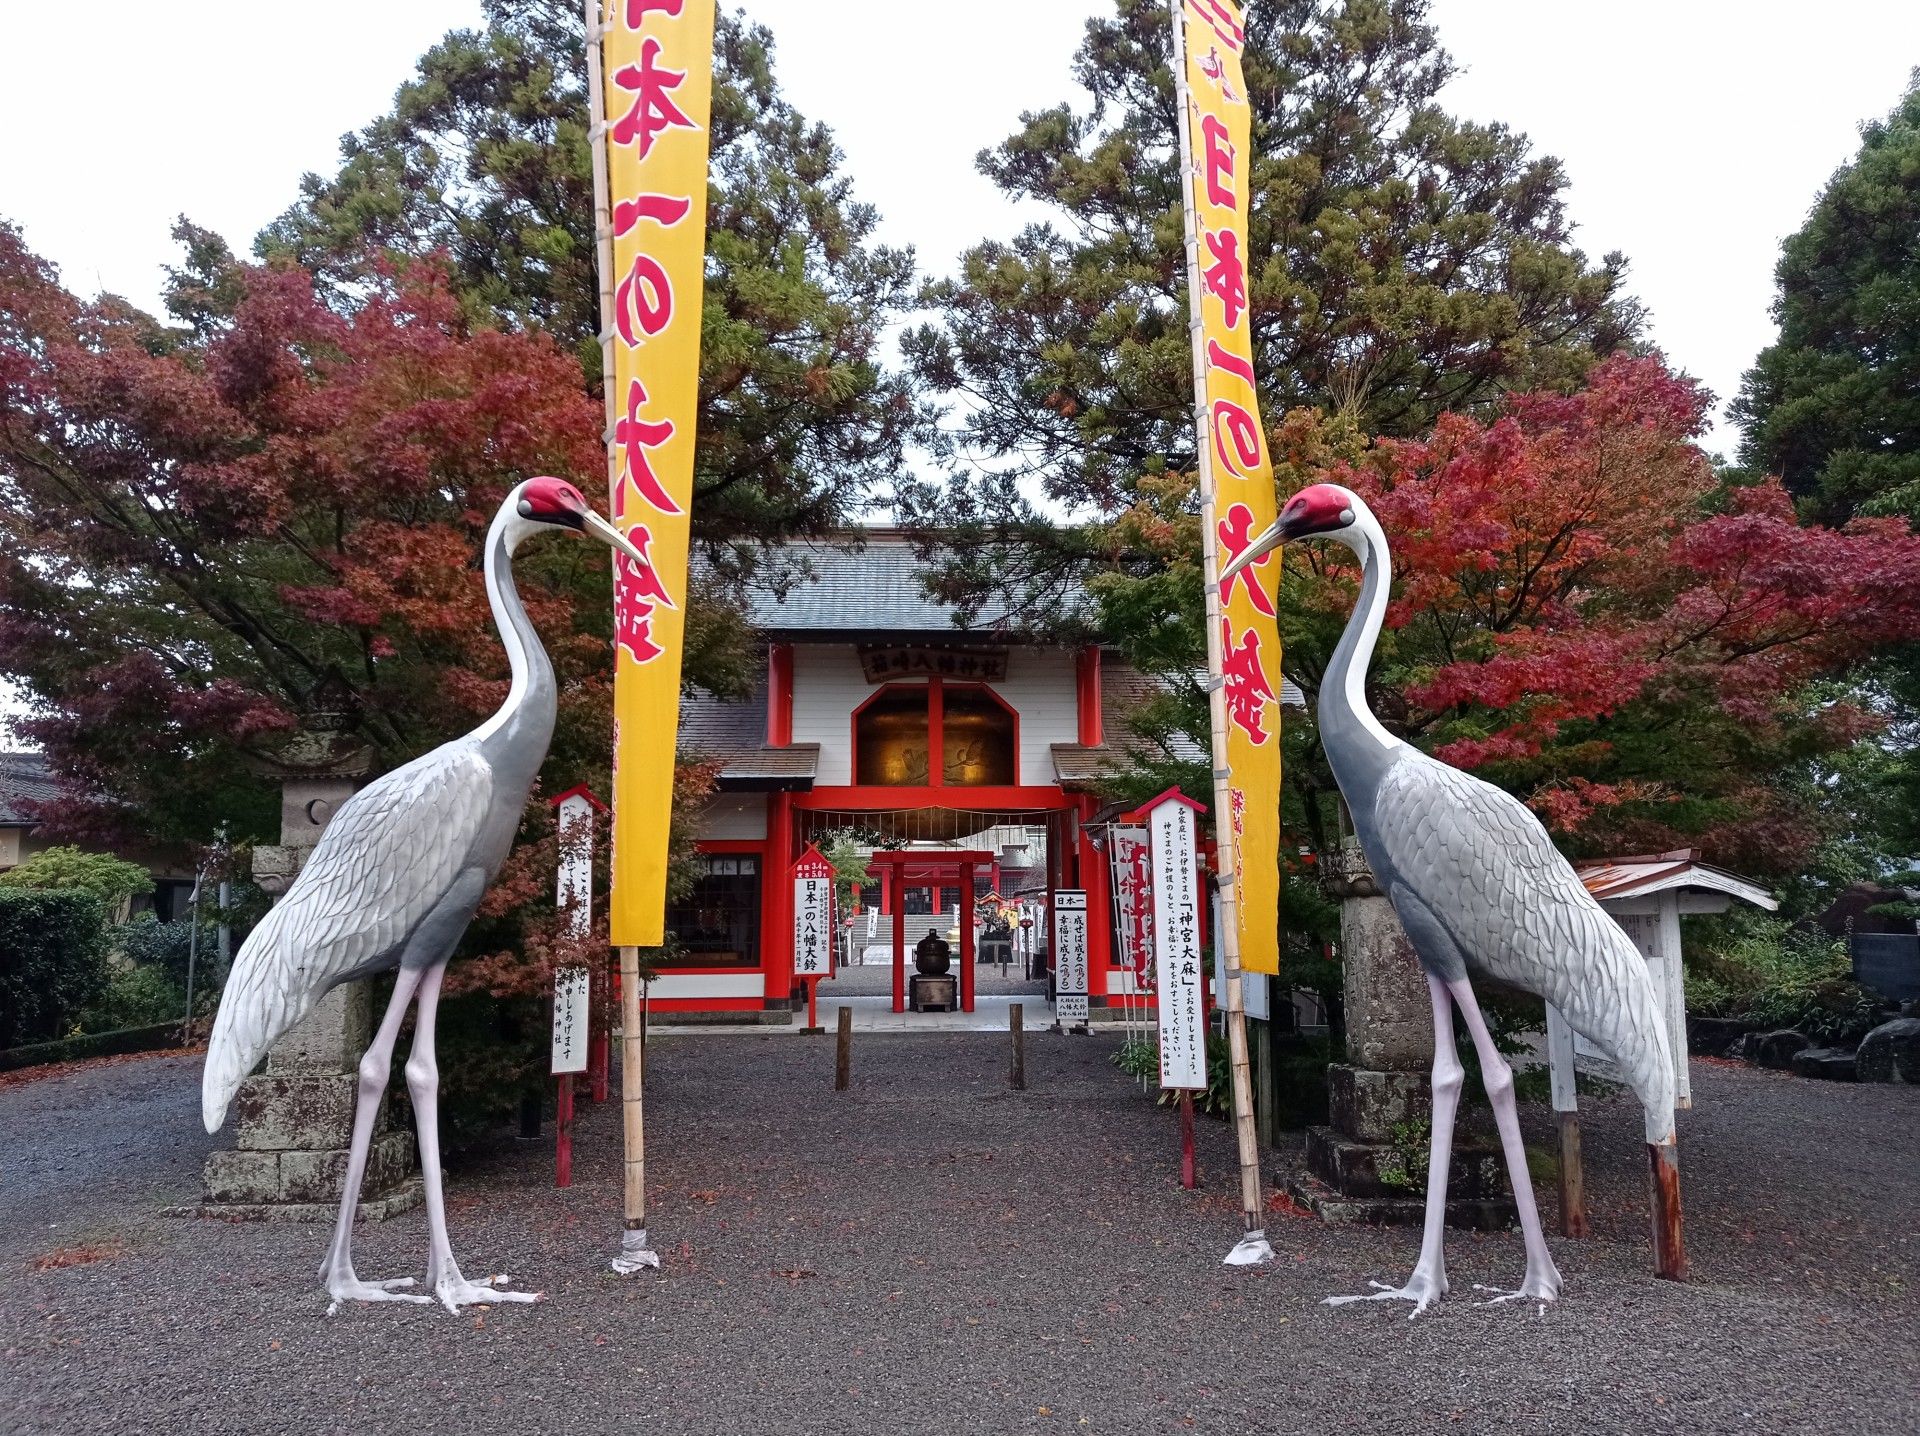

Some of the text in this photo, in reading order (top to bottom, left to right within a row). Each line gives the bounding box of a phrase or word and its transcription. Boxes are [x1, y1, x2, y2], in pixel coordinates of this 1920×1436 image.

[803, 880, 819, 971] 日本一の八幡大鈴
[1057, 896, 1085, 905] 日本一
